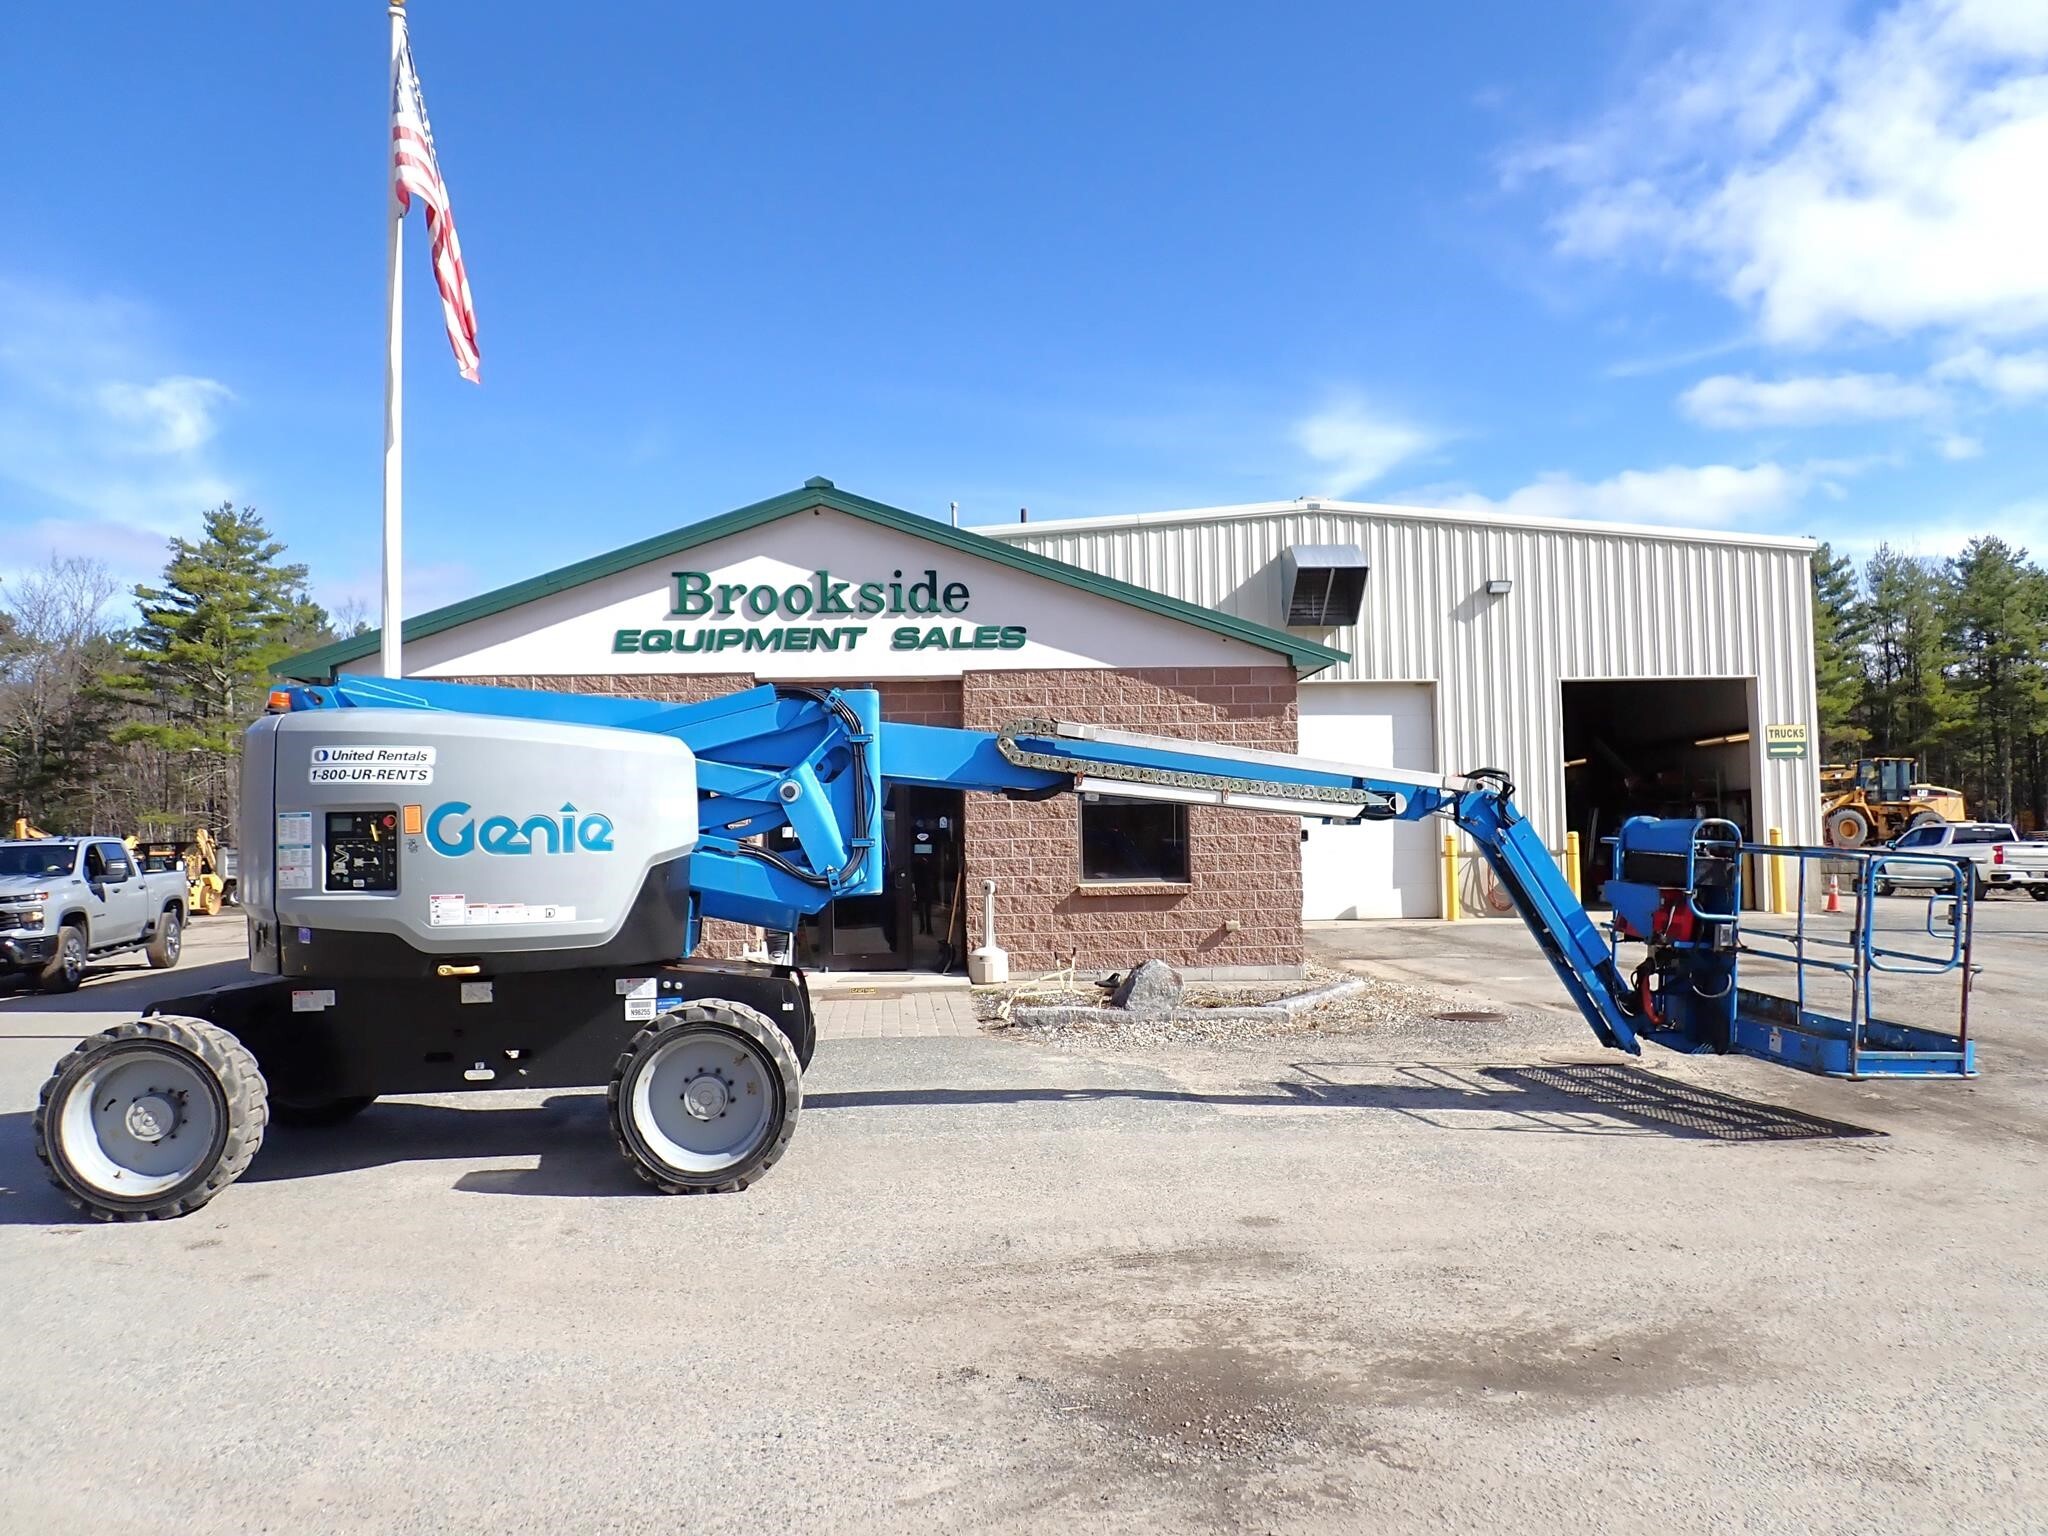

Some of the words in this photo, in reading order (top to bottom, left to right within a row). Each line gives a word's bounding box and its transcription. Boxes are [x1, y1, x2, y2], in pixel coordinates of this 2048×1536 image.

[671, 569, 970, 615] Brookside
[613, 627, 868, 653] EQUIPMENT
[892, 625, 1027, 650] SALES
[1768, 728, 1805, 739] TRUCKS
[331, 749, 375, 761] United
[377, 750, 428, 762] Rentals
[311, 768, 428, 781] 1-800-UR-RENTS
[425, 800, 615, 857] Genie
